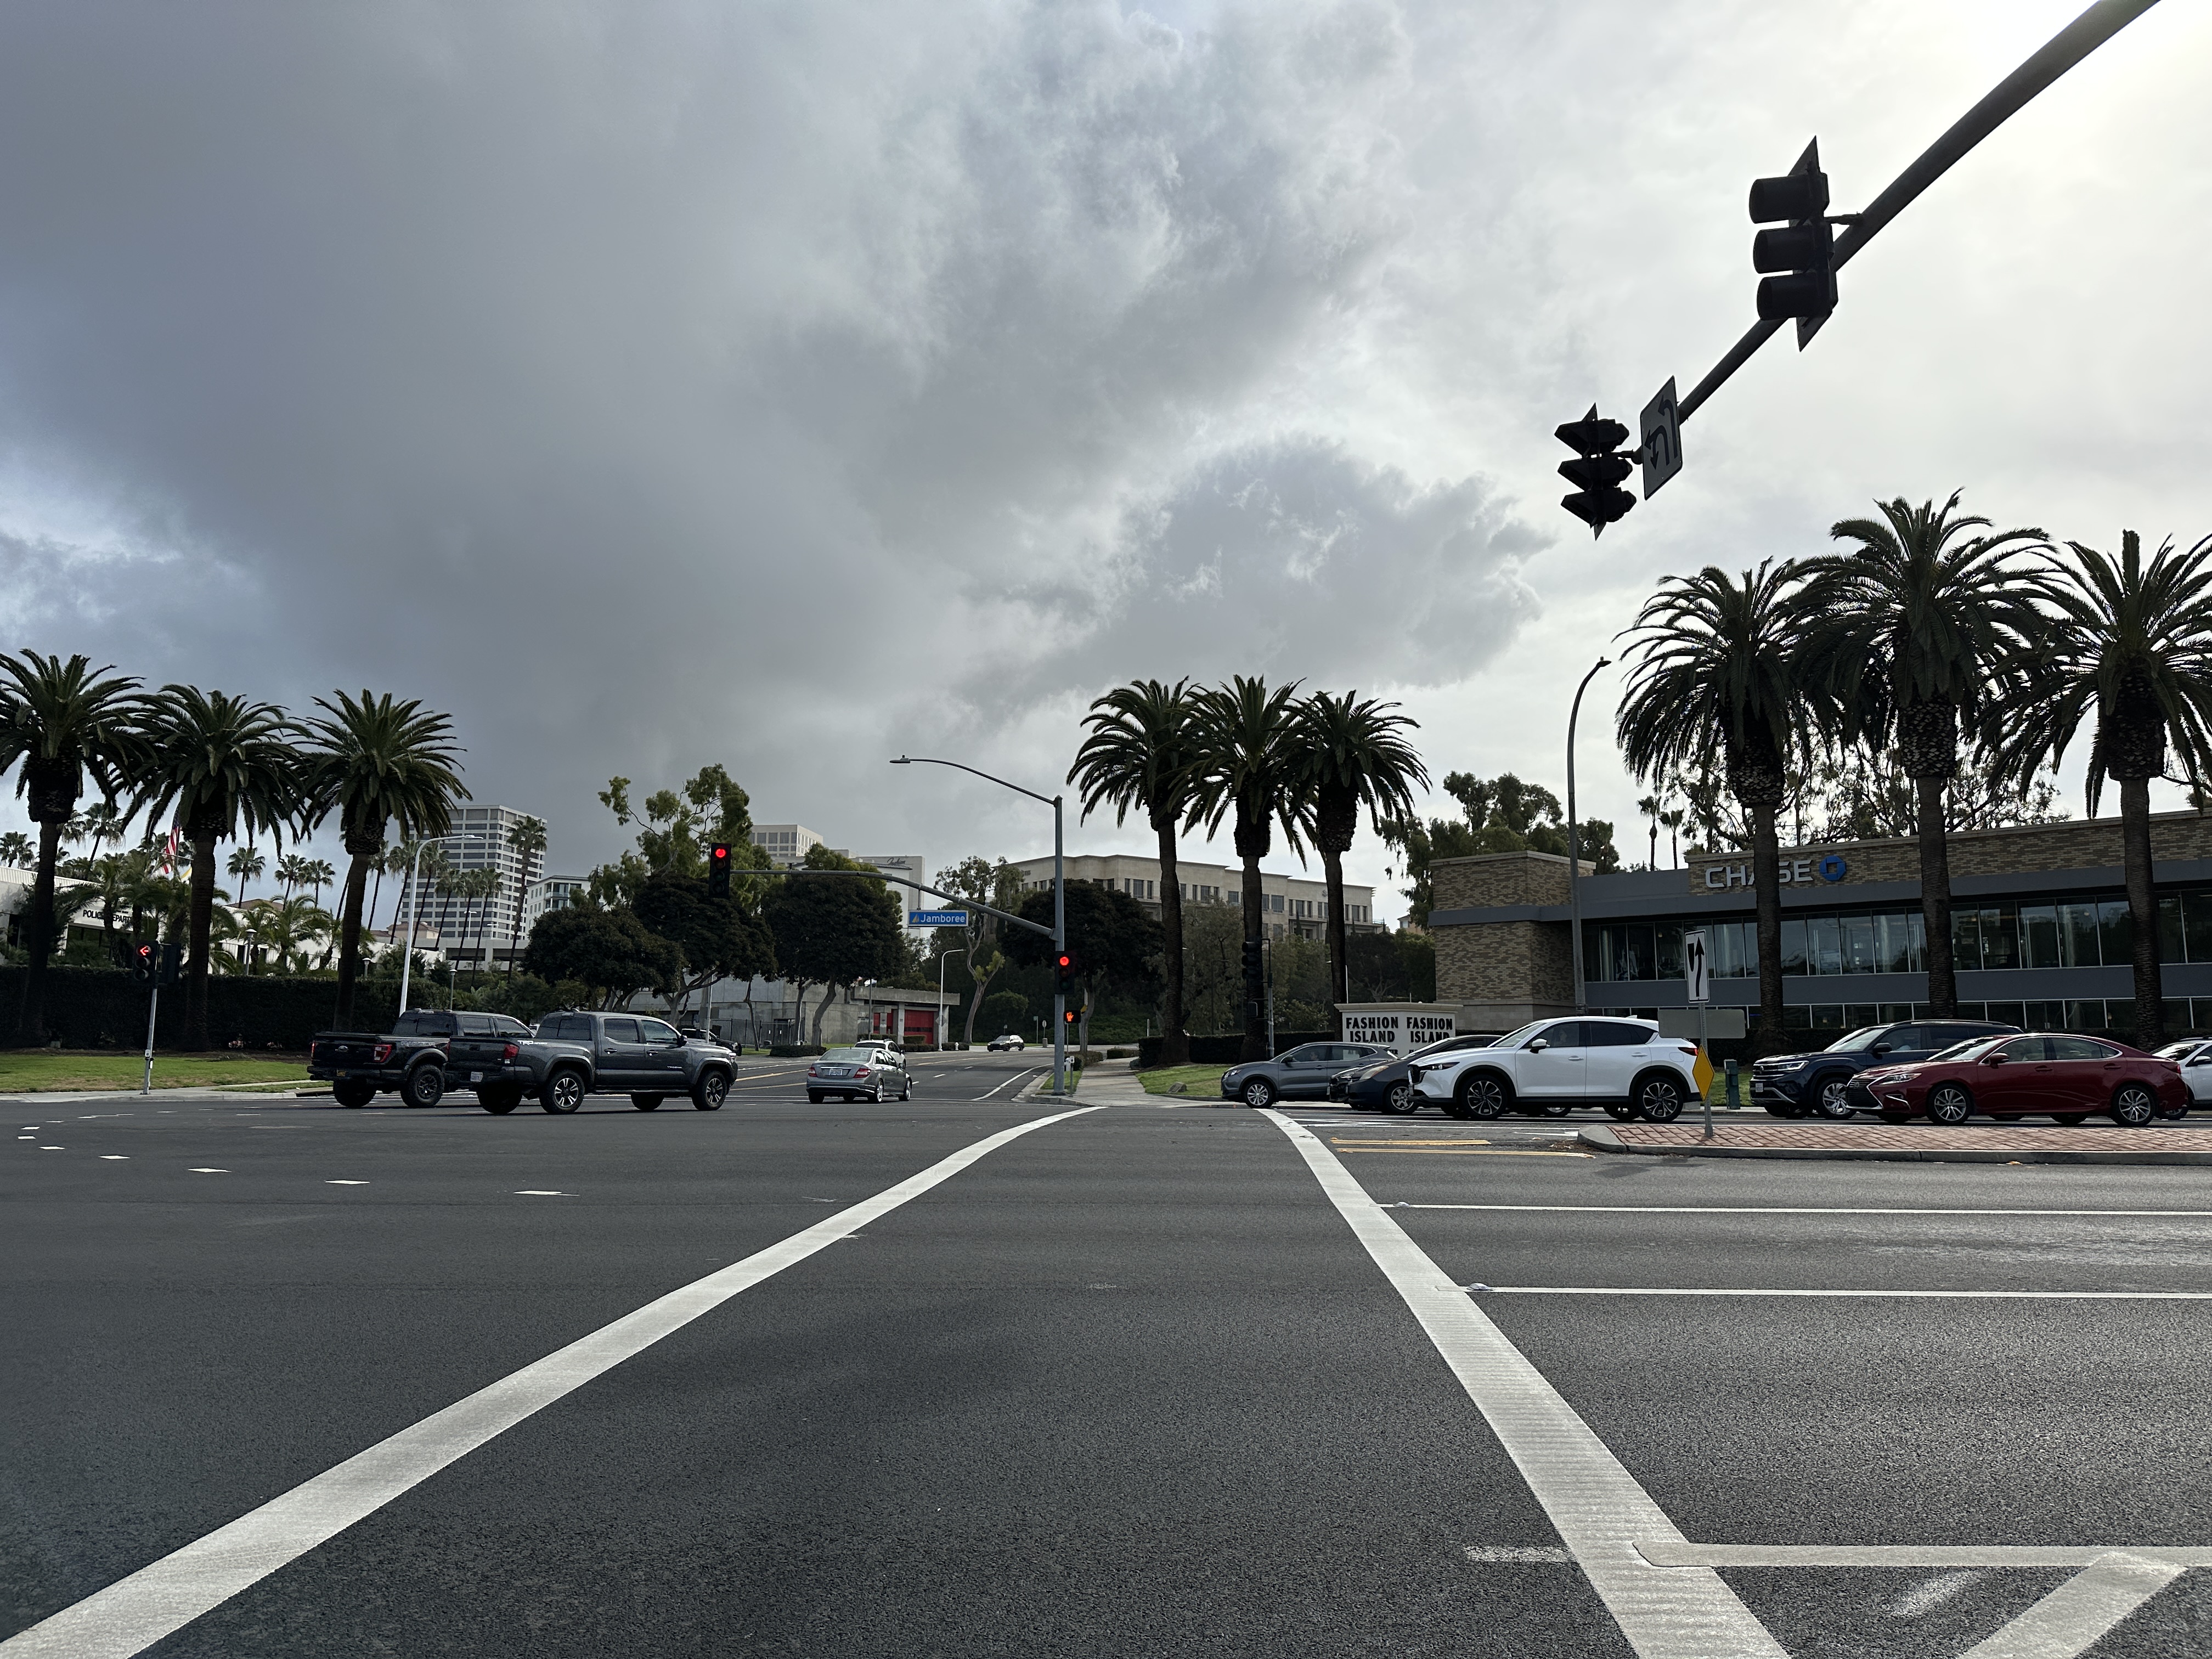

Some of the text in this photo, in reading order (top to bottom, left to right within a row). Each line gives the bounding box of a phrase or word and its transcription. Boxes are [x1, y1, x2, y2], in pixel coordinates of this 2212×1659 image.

[1705, 860, 1813, 888] CHSE
[83, 910, 104, 920] POLIC
[921, 913, 966, 923] Jamboree
[1346, 1017, 1399, 1029] FASHION
[1407, 1017, 1453, 1030] FASHION
[1350, 1031, 1395, 1043] ISLAND
[1410, 1031, 1450, 1043] ISLAND
